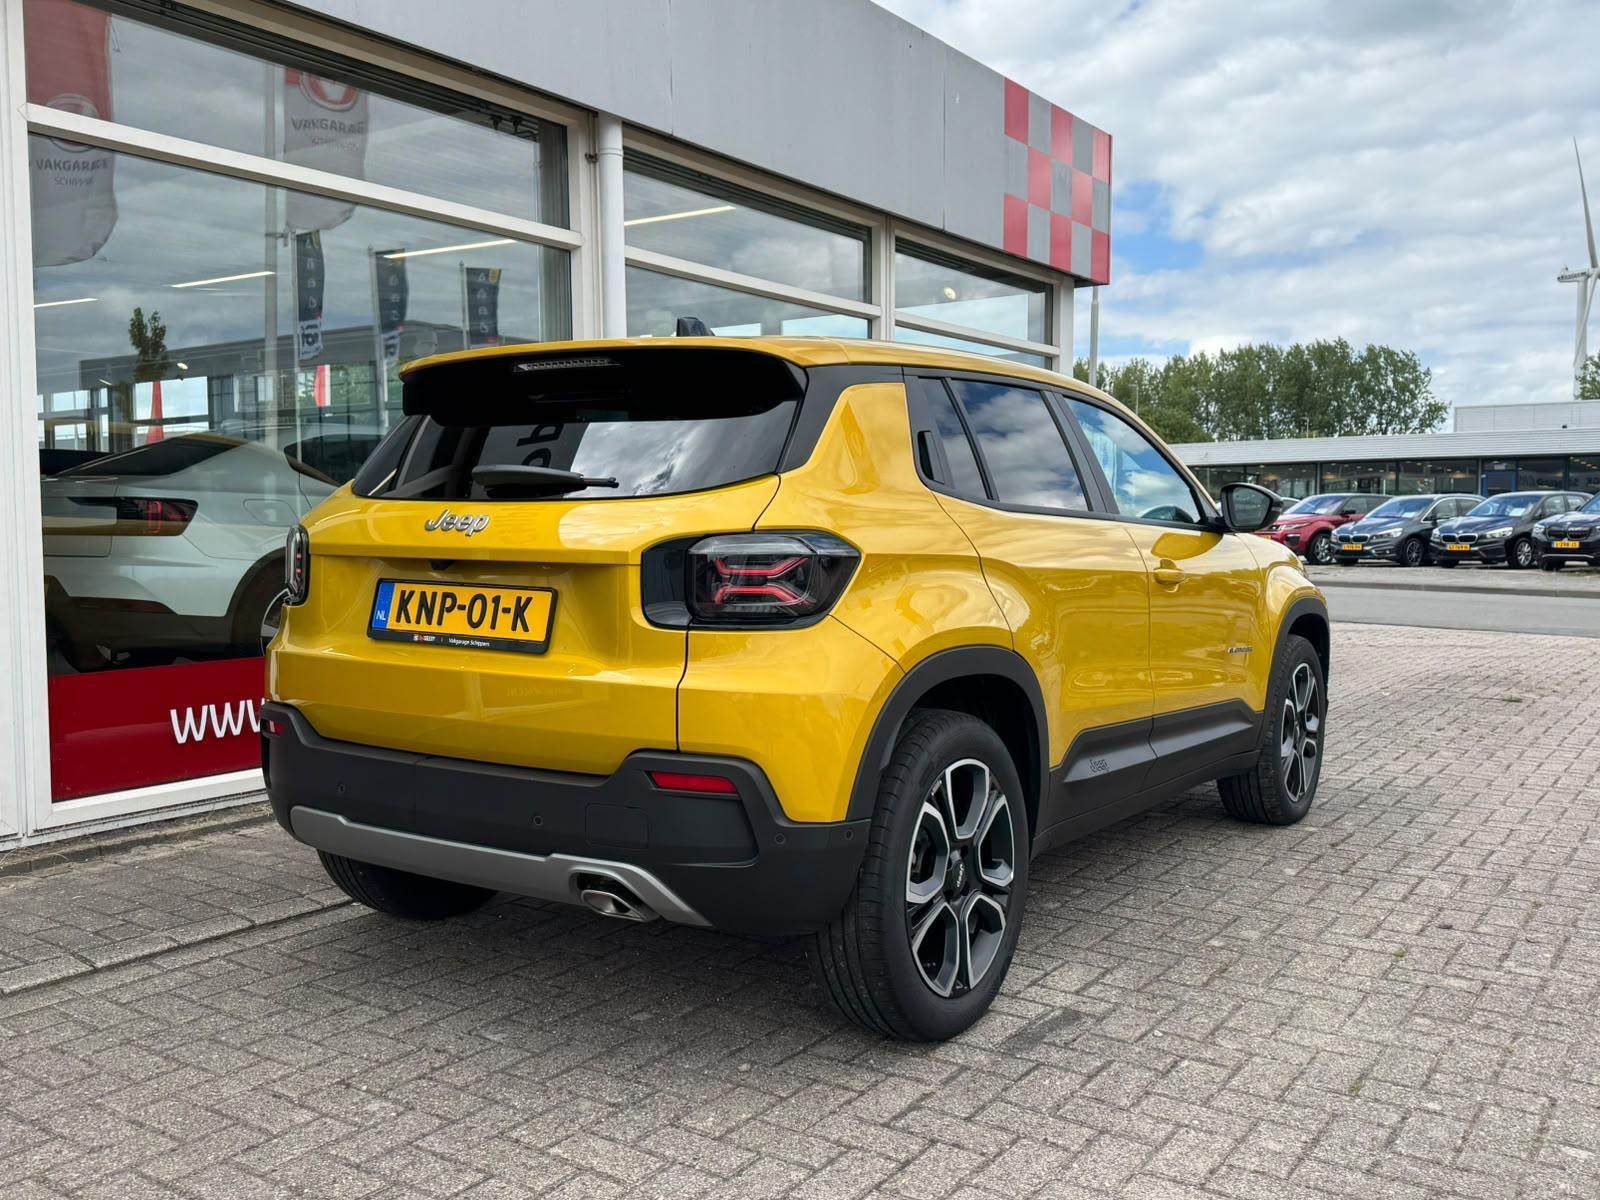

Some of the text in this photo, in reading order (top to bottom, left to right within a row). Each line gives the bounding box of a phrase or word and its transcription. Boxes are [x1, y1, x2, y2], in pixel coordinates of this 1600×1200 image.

[290, 117, 367, 135] VAKGARAG
[425, 509, 490, 537] Jeep
[375, 589, 533, 632] NL KNP-01-K
